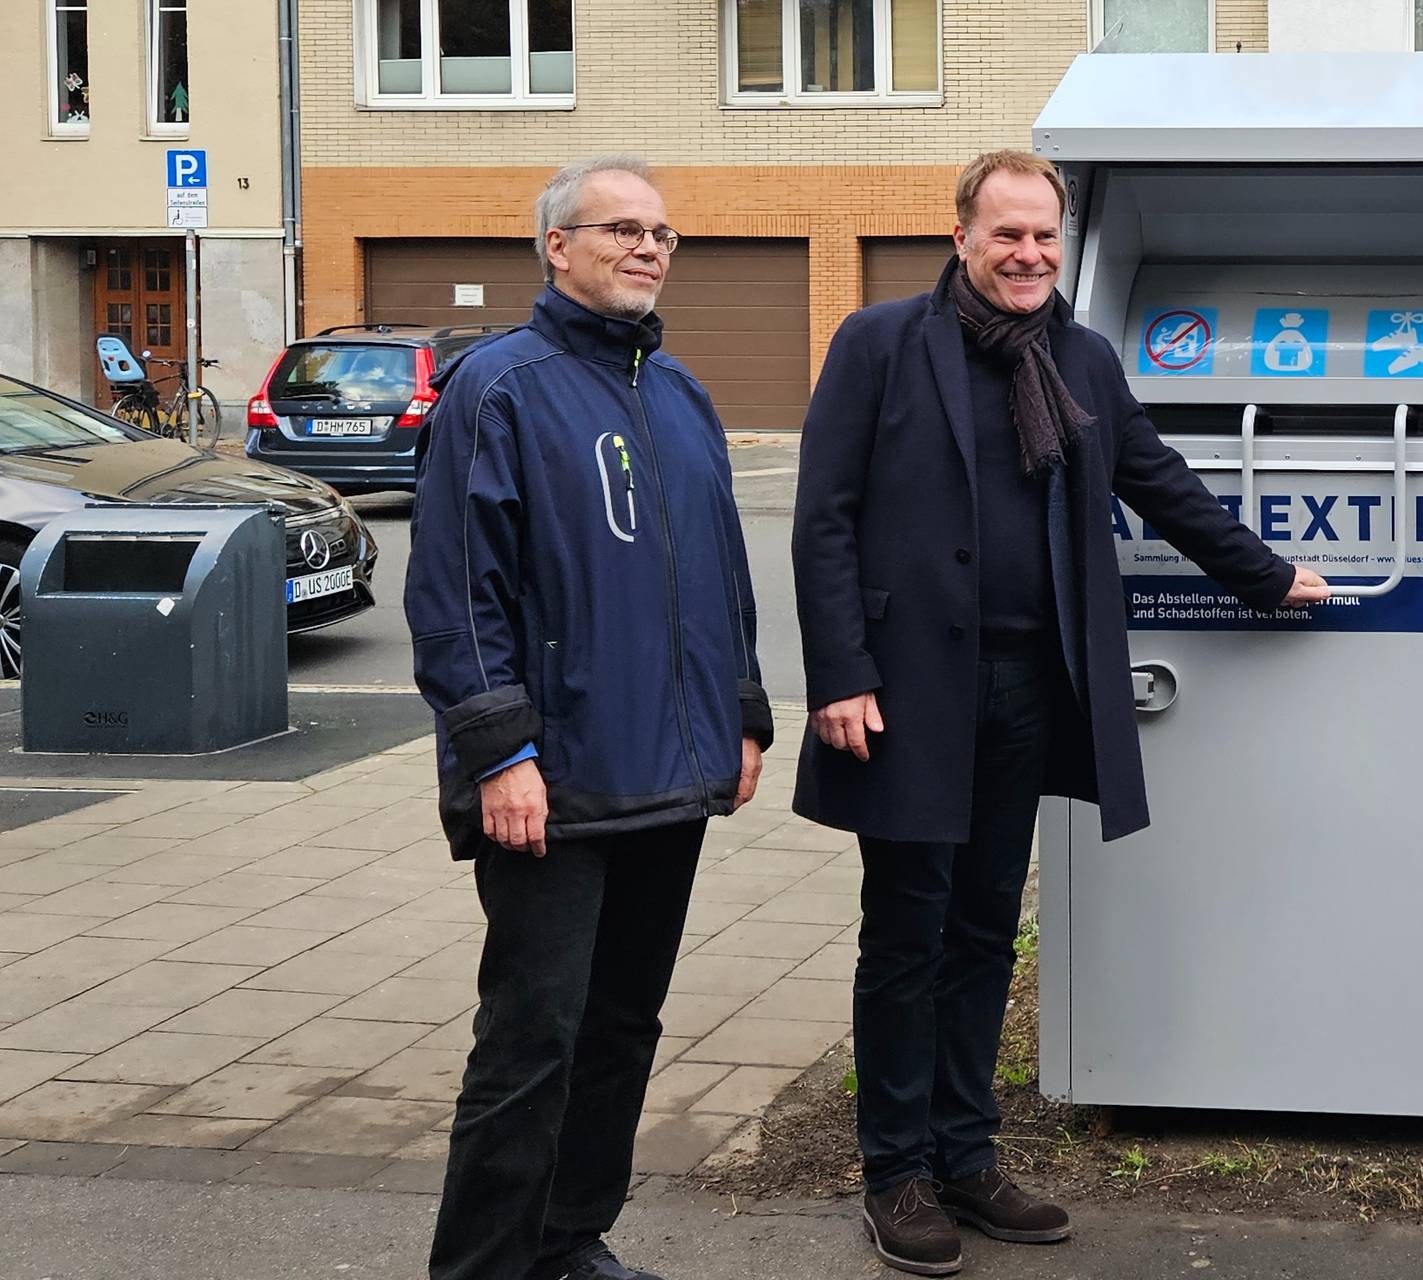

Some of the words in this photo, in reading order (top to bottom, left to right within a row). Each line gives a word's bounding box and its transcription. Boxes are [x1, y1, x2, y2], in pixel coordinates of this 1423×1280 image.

[175, 154, 198, 187] P
[237, 177, 249, 190] 13
[317, 421, 323, 432] D
[346, 421, 366, 432] 765
[1134, 554, 1179, 563] Sammlung
[1322, 554, 1368, 563] Düsseldorf
[295, 582, 300, 598] D
[309, 577, 322, 595] US
[1133, 593, 1154, 604] Das
[1158, 593, 1214, 604] Abstellen
[1133, 607, 1155, 619] und
[1158, 607, 1235, 619] Schadstoffen
[1238, 607, 1253, 619] ist
